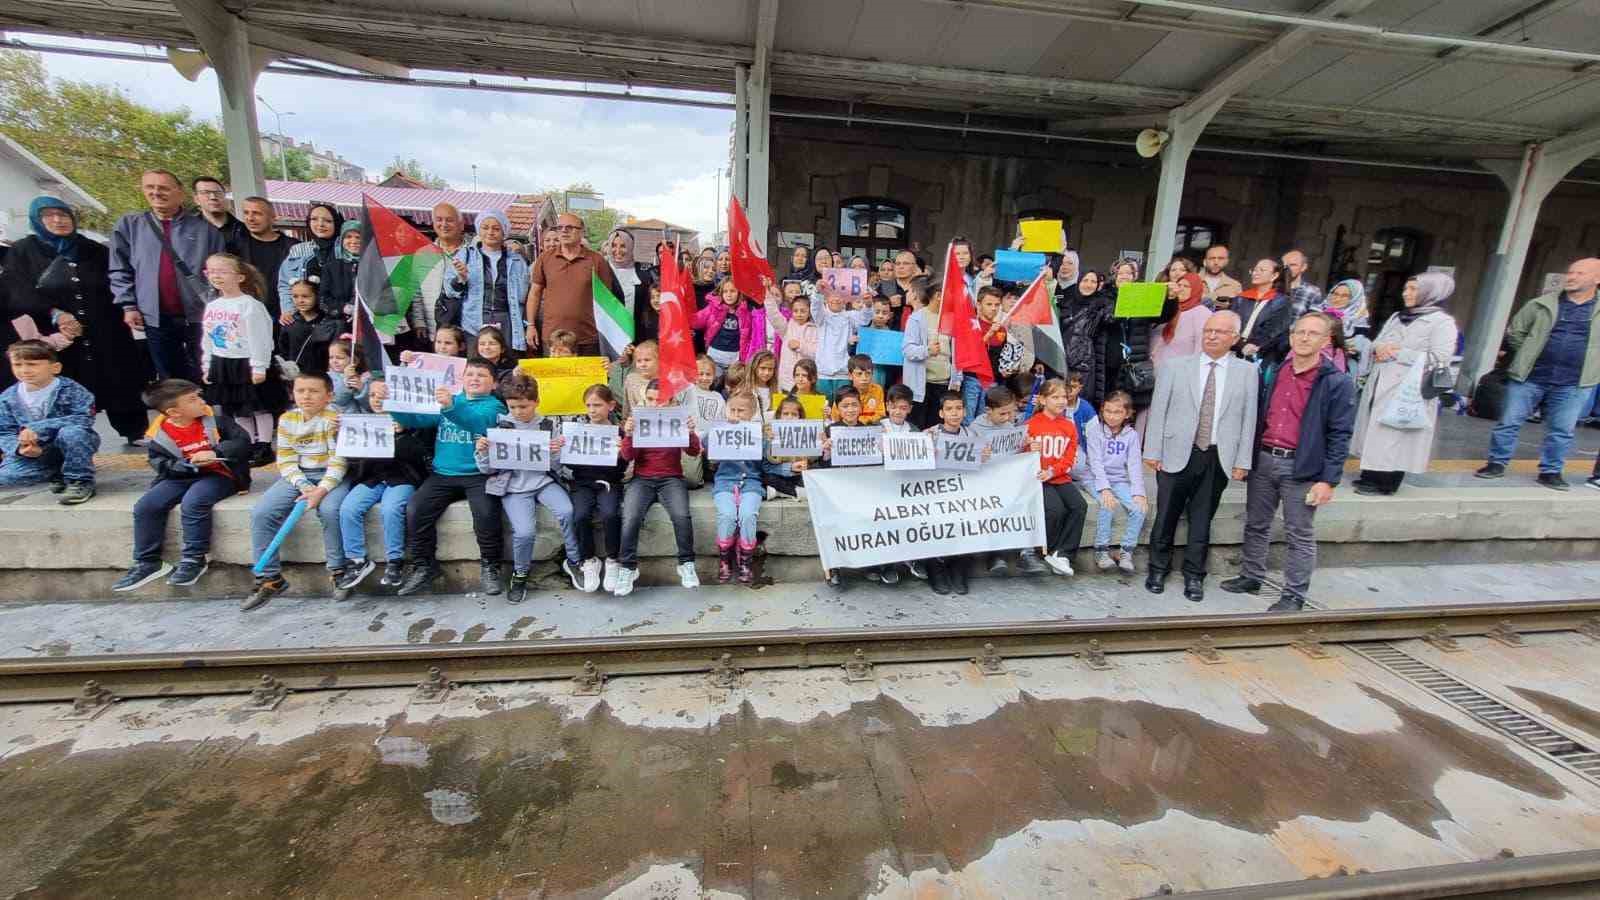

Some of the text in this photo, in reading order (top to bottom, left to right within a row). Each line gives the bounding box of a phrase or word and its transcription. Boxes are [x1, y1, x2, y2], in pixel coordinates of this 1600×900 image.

[344, 421, 387, 448] BİR
[639, 413, 681, 438] BİR
[715, 426, 755, 449] YEŞİL
[778, 425, 818, 449] VATAN
[496, 437, 541, 462] BİR
[569, 431, 612, 456] AİLE
[889, 437, 928, 461] UMUTLA
[944, 441, 976, 462] YOL
[900, 473, 964, 498] KARESİ
[873, 496, 1004, 522] ALBAY TAYYAR
[834, 528, 901, 552] NURAN
[906, 521, 956, 544] OĞUZ
